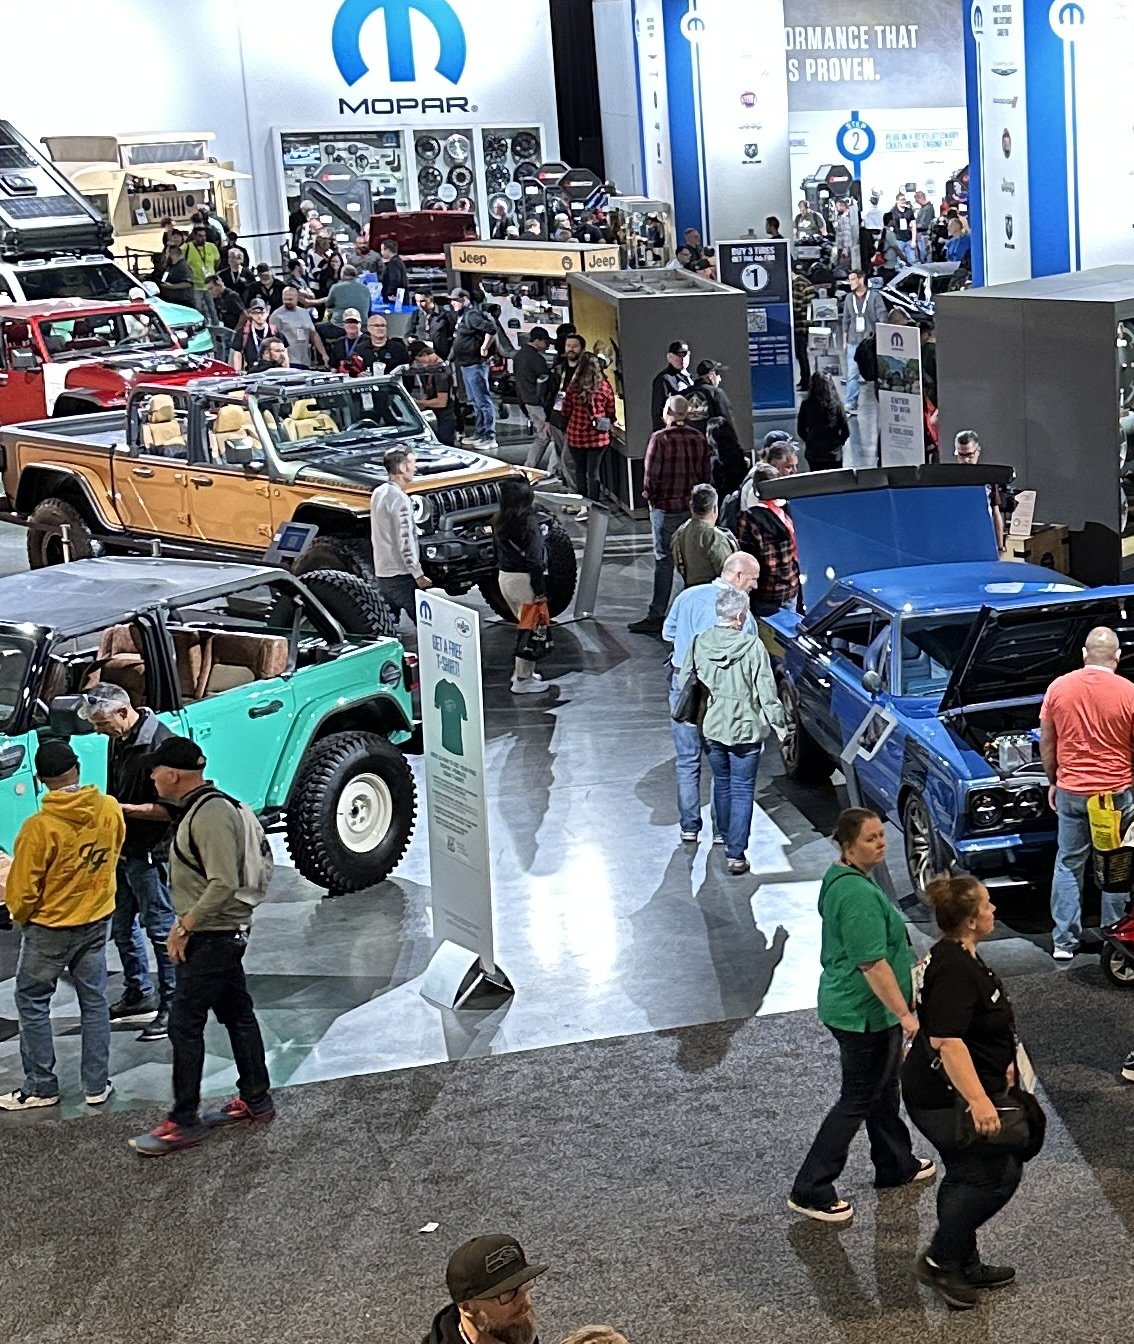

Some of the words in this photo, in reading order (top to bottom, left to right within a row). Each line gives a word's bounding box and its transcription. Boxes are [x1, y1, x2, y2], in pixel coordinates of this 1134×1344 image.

[785, 25, 869, 51] ORMANCE
[874, 25, 919, 49] THAT
[788, 58, 800, 82] S
[805, 57, 881, 82] PROVEN.
[338, 96, 471, 115] MOPAR
[852, 131, 861, 151] 2
[459, 250, 487, 266] Jeep
[588, 255, 616, 268] Jeep
